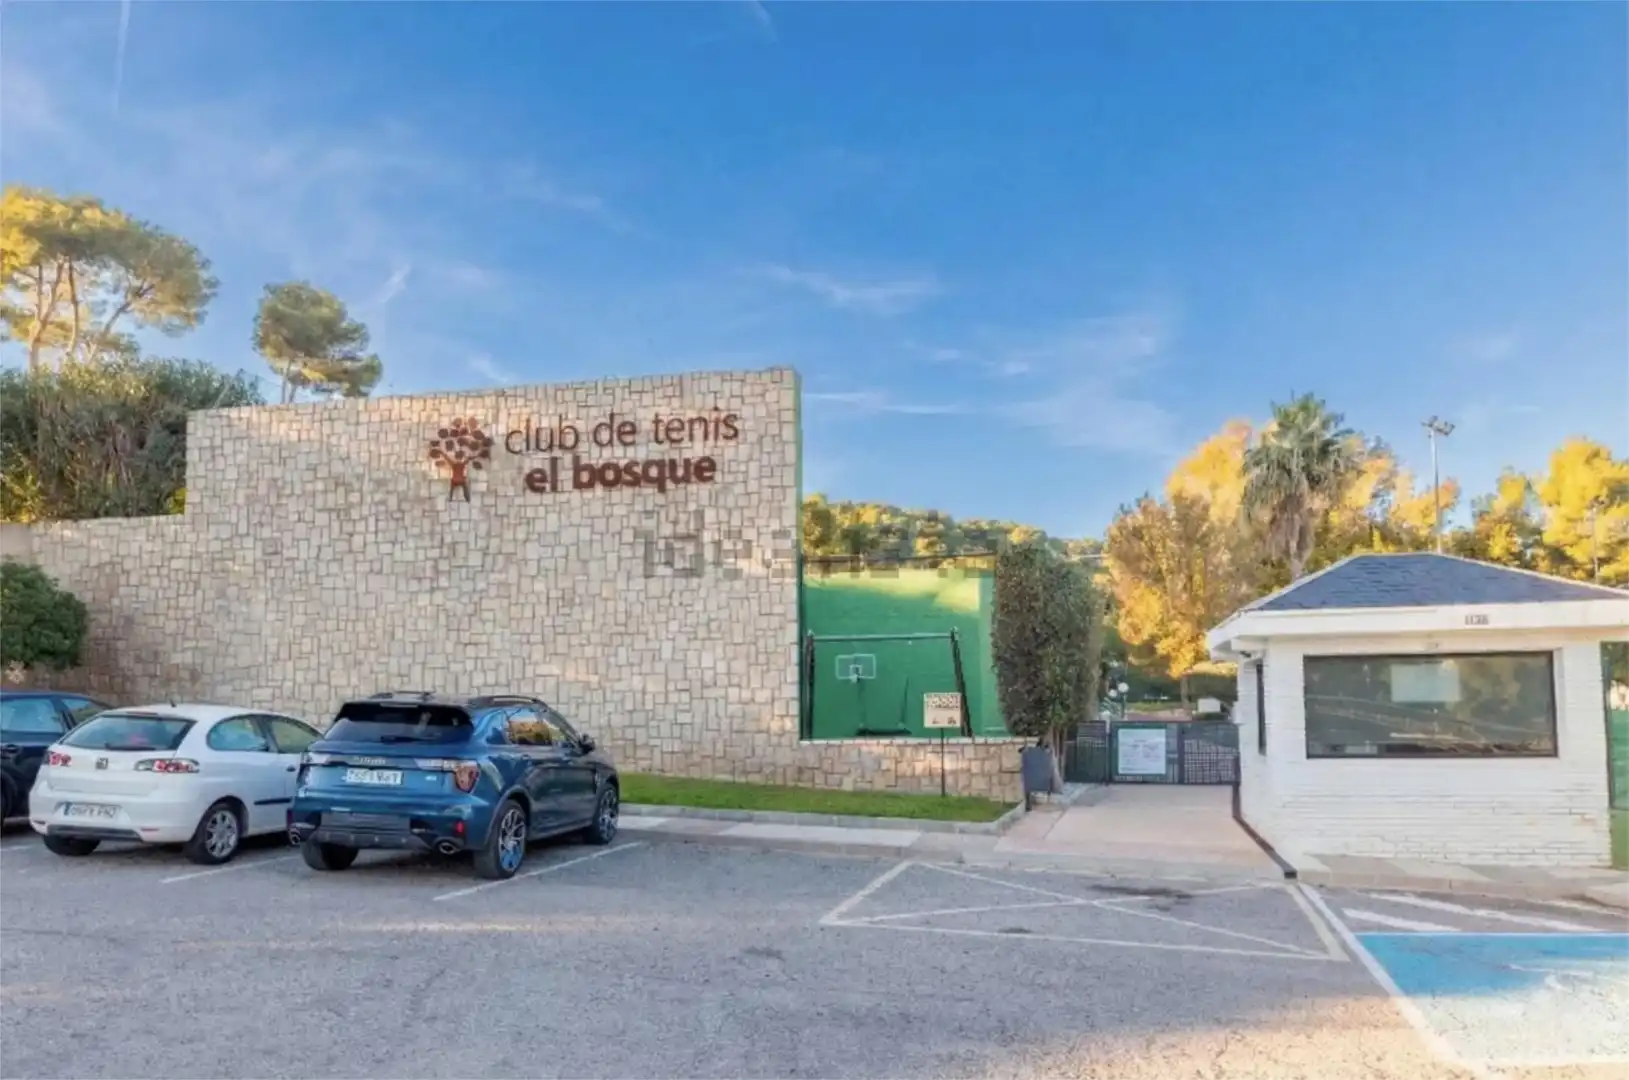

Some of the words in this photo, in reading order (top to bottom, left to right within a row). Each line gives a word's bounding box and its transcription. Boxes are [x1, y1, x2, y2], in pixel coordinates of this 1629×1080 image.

[505, 414, 580, 454] club
[593, 412, 637, 447] de
[652, 406, 740, 445] tenis
[525, 456, 559, 493] el
[572, 454, 717, 494] bosque
